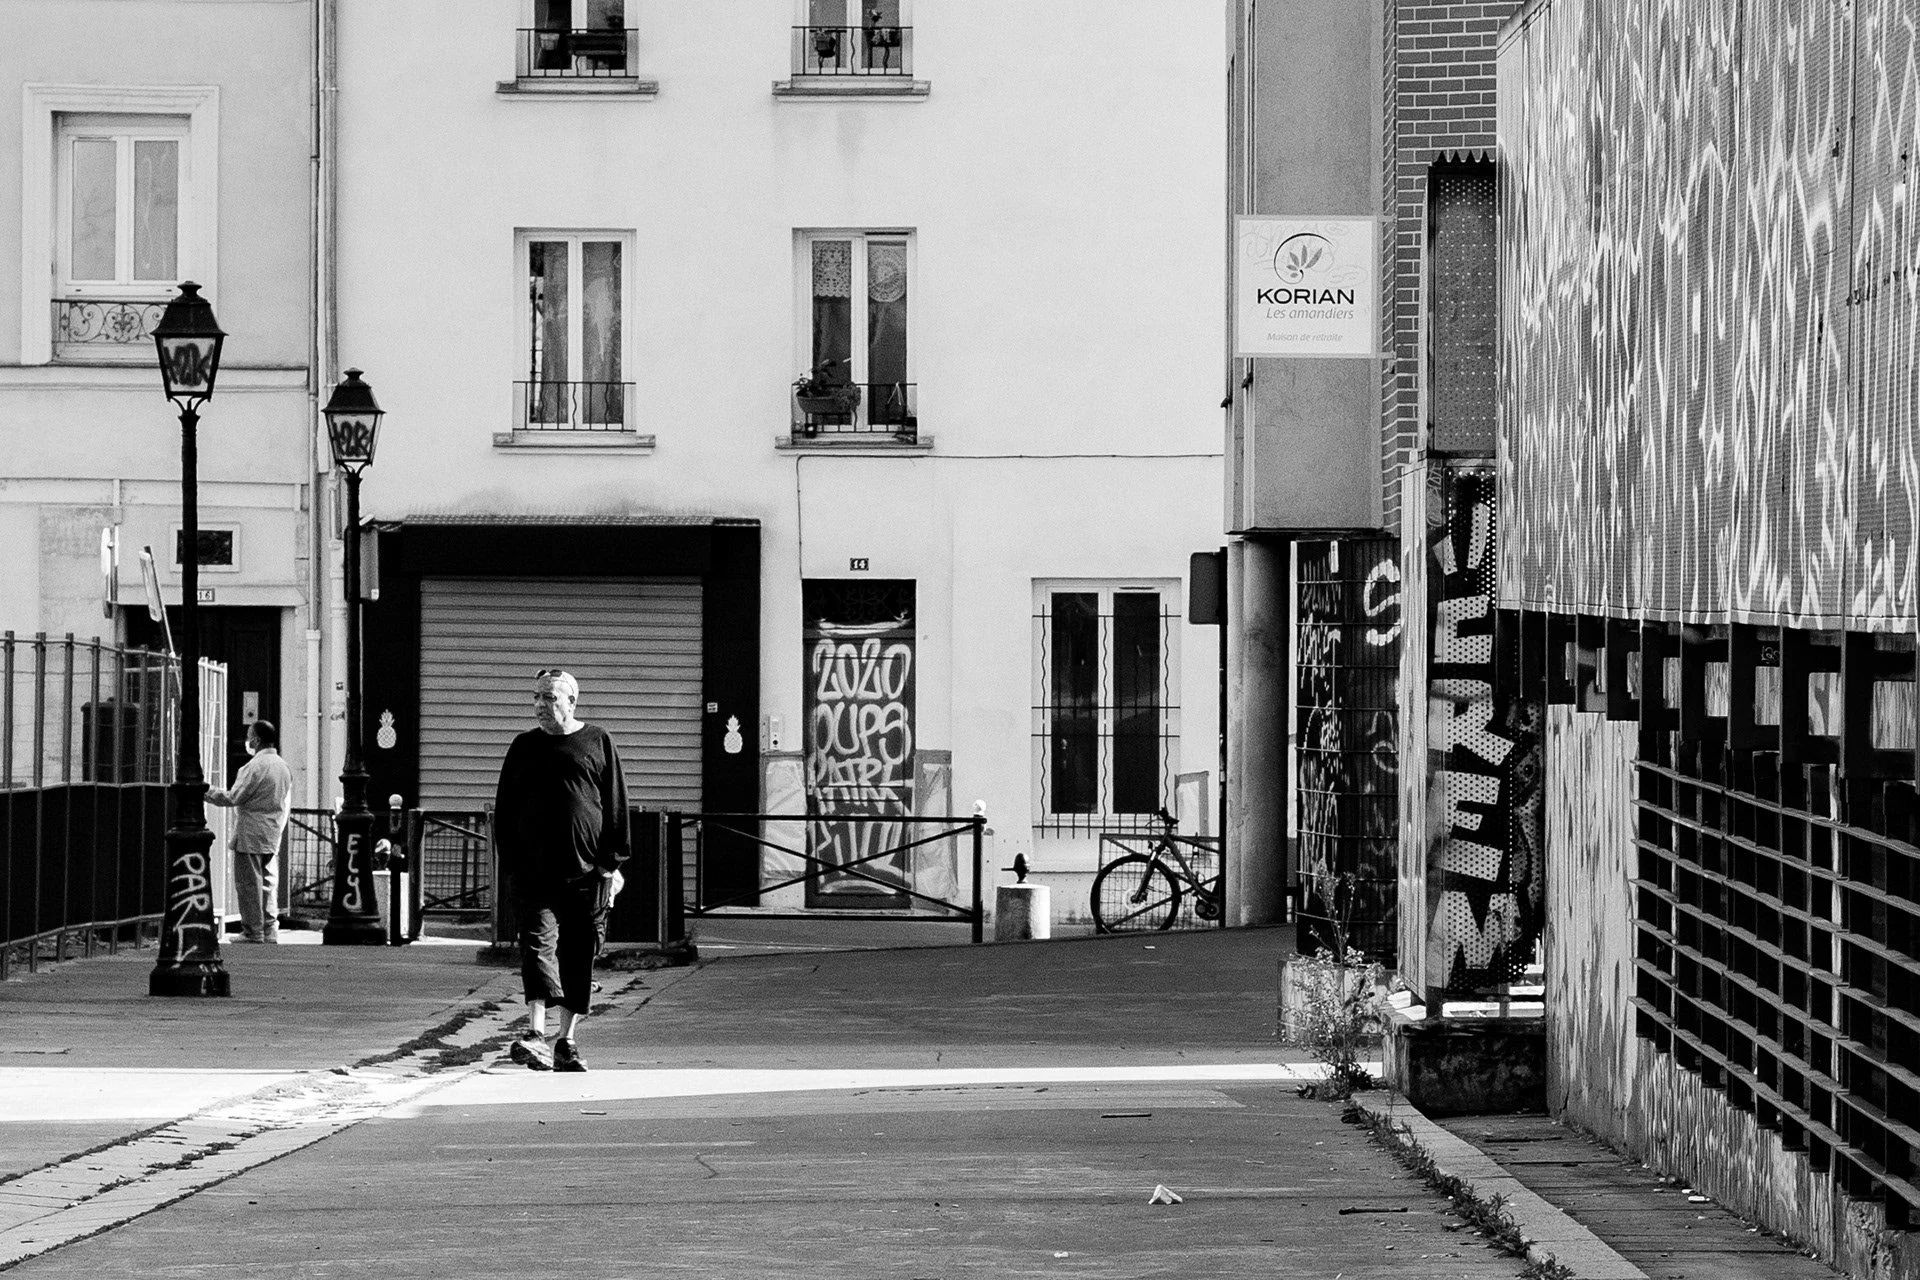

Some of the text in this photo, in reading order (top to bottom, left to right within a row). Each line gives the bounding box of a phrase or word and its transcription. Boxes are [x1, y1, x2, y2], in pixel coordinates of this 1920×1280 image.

[1257, 288, 1355, 305] KORIAN
[1266, 307, 1354, 319] Les amandiers
[1266, 332, 1344, 341] Maison de retraite
[813, 637, 912, 700] 2020
[809, 701, 912, 766] OUPS
